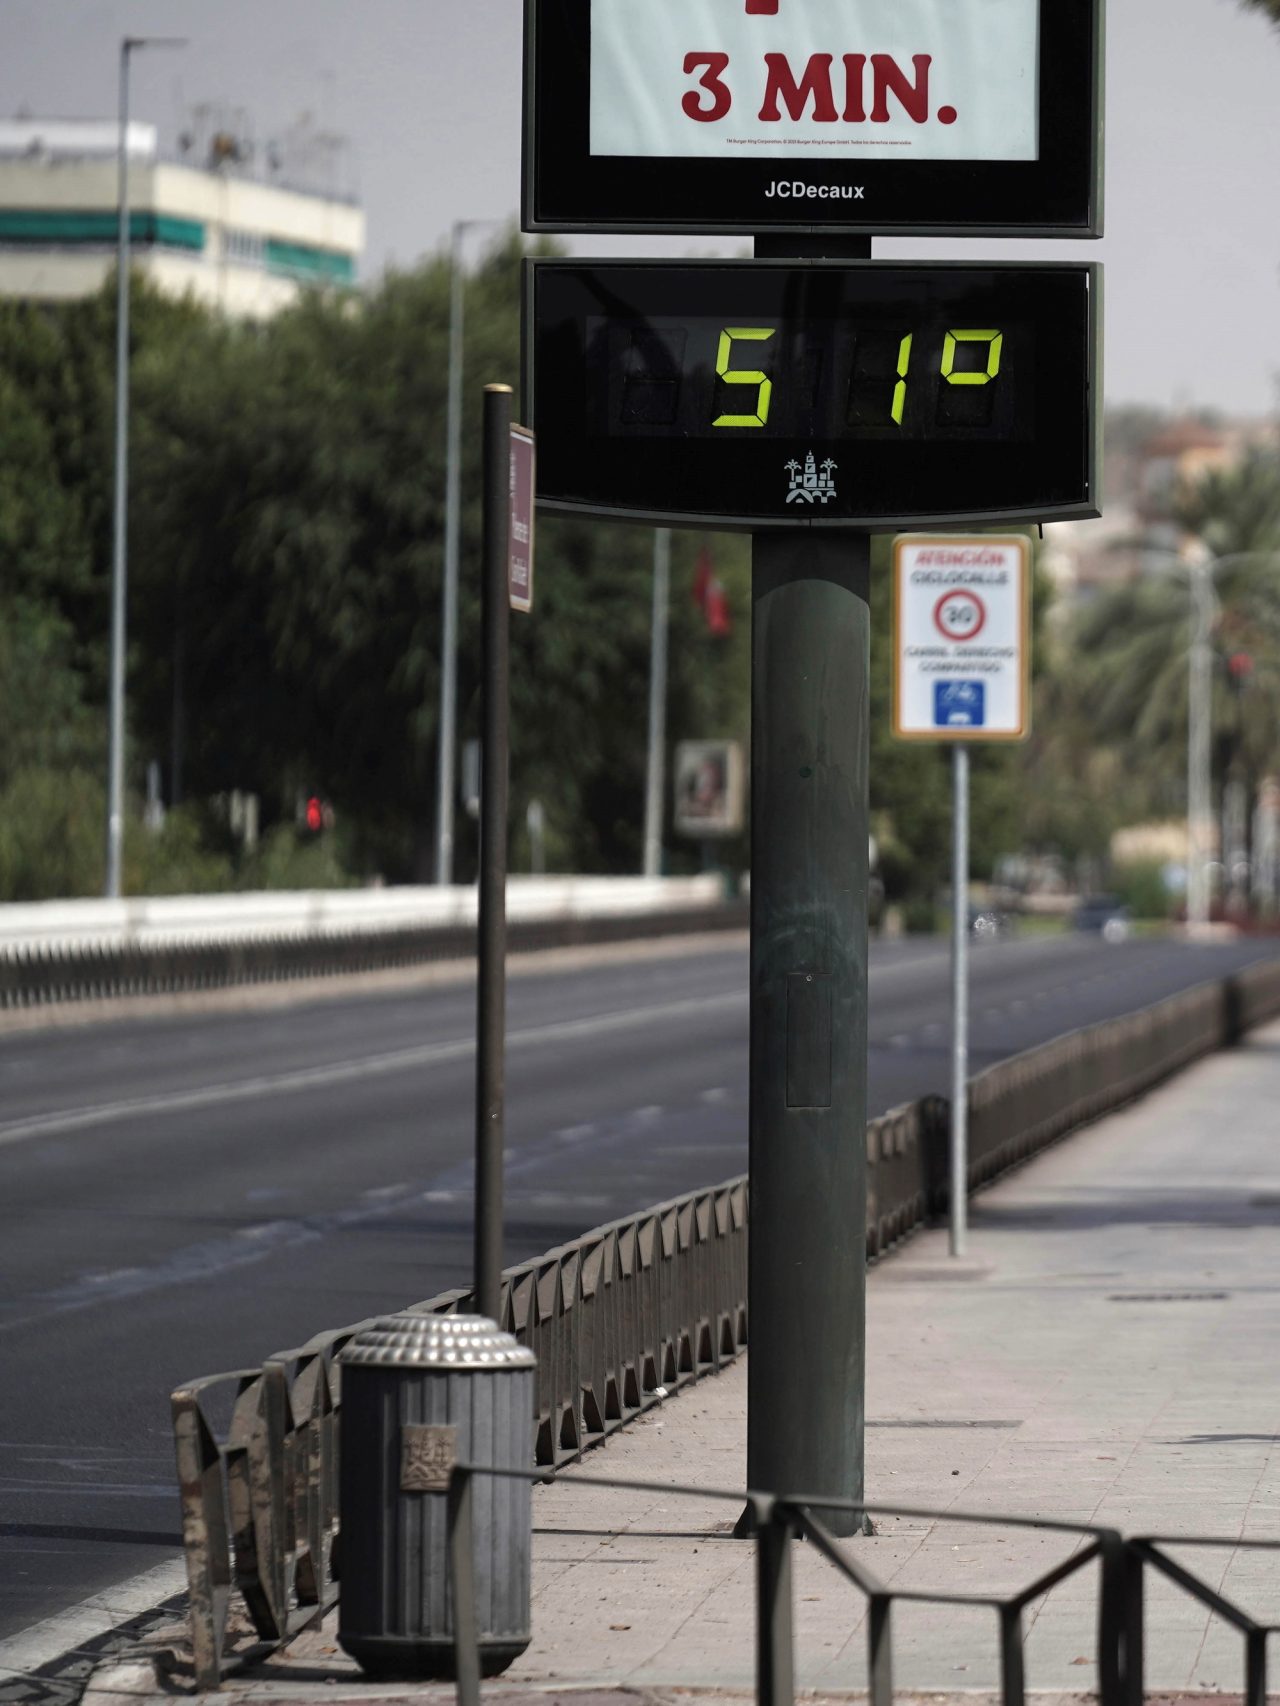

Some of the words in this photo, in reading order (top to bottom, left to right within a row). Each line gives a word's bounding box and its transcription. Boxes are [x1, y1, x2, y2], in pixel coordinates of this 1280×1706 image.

[681, 51, 732, 123] 3
[757, 53, 958, 125] MIN.
[764, 180, 865, 200] JCDecaux
[914, 546, 1006, 566] ATENCIÓN
